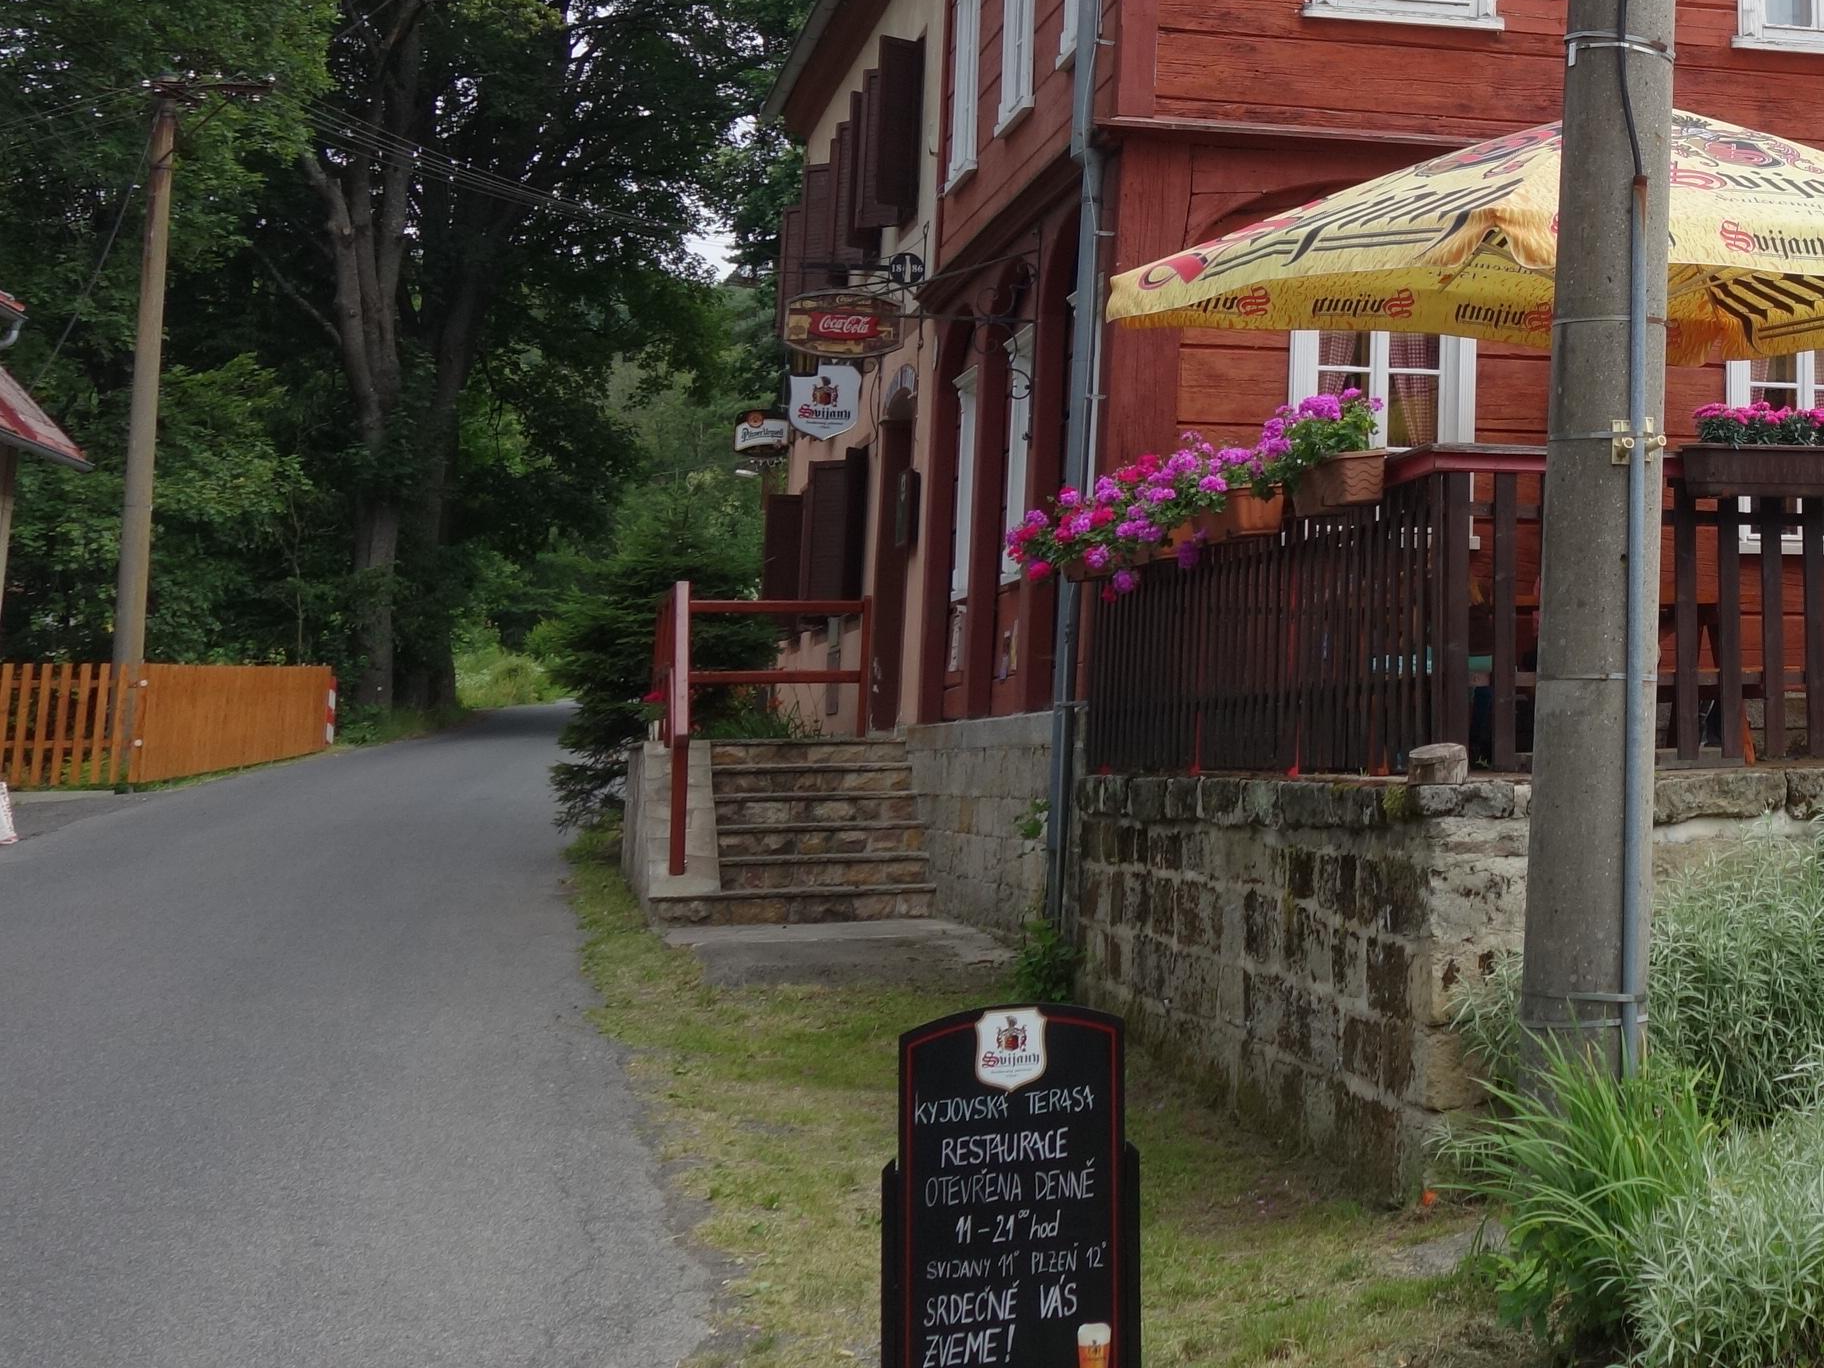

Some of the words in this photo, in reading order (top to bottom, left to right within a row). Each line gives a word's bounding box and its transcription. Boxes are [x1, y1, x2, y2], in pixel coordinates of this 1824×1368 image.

[911, 264, 923, 272] 86
[798, 403, 851, 420] Svijany
[982, 1051, 1040, 1068] Svijany
[914, 1091, 1009, 1125] KYJOVSKÁ
[1025, 1085, 1095, 1115] TERASA
[941, 1127, 1069, 1168] RESTAURACE
[925, 1168, 1022, 1207] OTEVŘENA
[1034, 1157, 1096, 1201] DENNĚ
[1029, 1209, 1061, 1241] hod
[926, 1258, 991, 1280] SVIJANY
[1031, 1242, 1078, 1275] PLZEŇ
[924, 1279, 1020, 1327] SRDEČNĚ
[1040, 1275, 1078, 1320] VÁS
